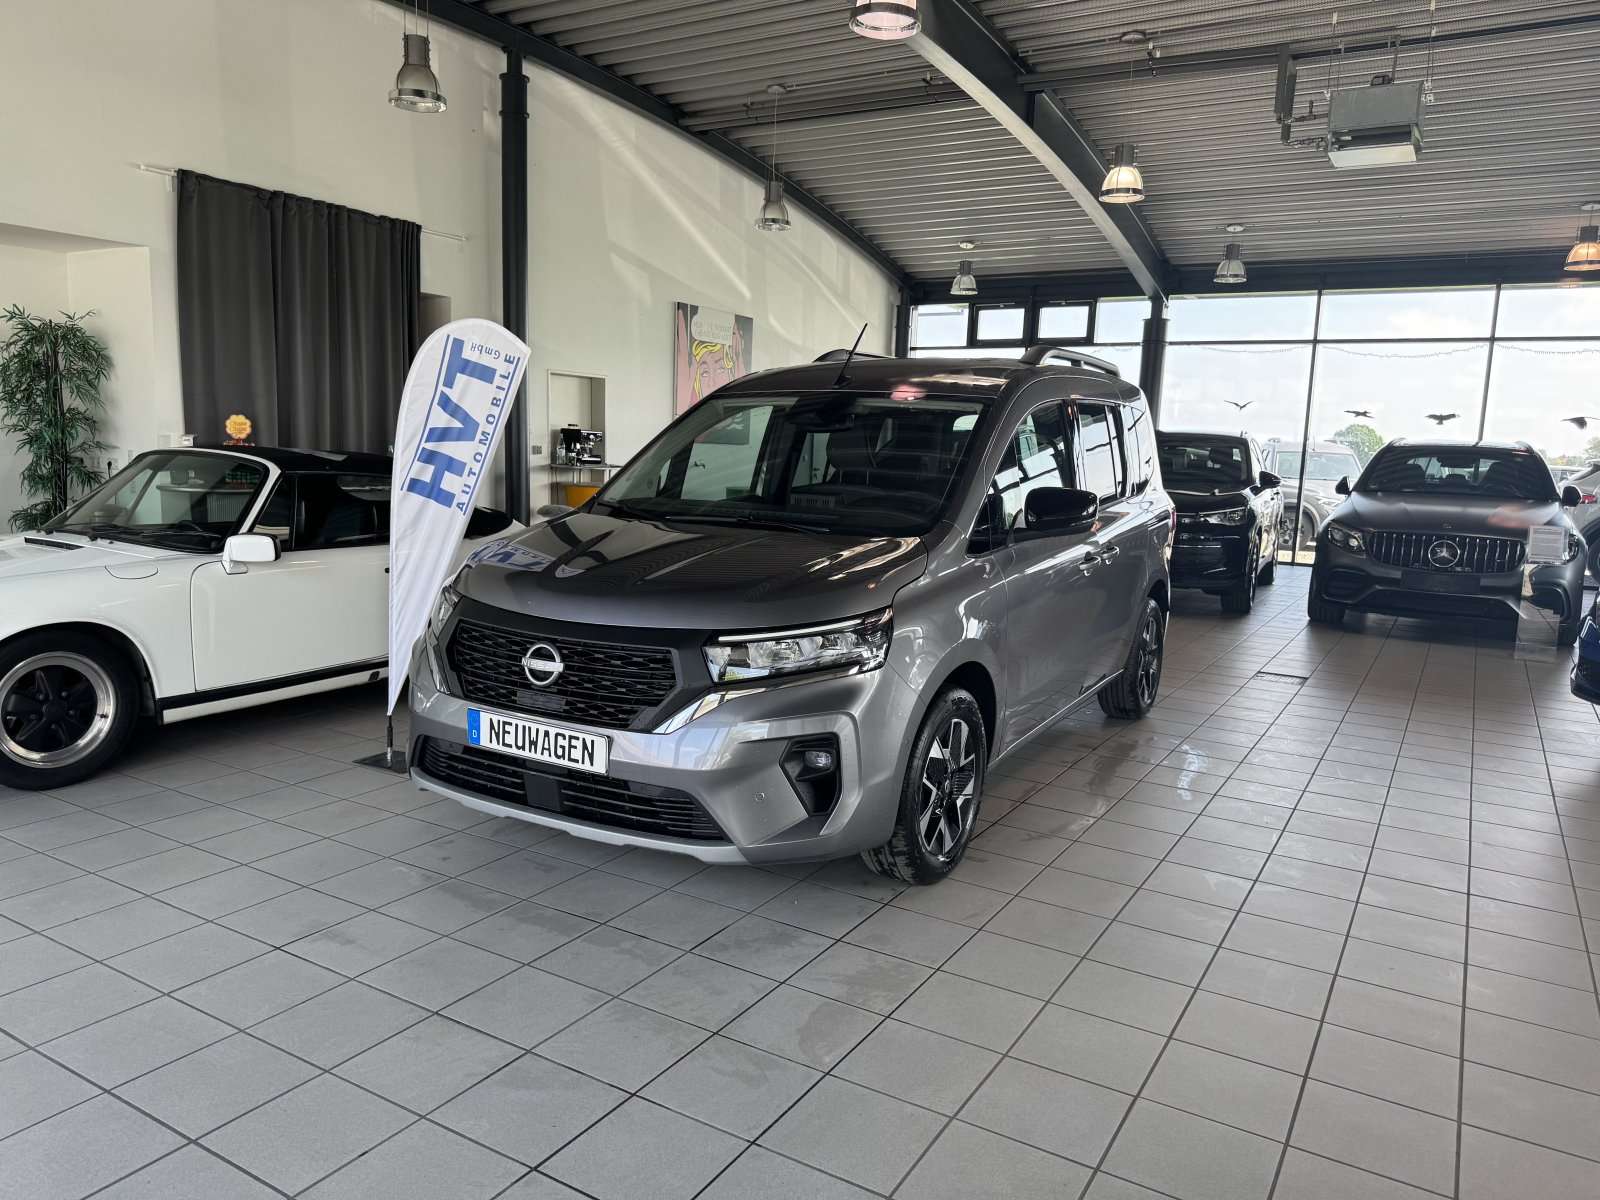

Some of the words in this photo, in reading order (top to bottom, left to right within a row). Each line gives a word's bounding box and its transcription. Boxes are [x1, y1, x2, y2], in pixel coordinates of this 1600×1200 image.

[470, 342, 501, 360] GmbH
[406, 337, 497, 509] HVT
[455, 353, 516, 513] AUTOMOBILE
[472, 729, 478, 738] D
[489, 717, 595, 767] NEUWAGEN
